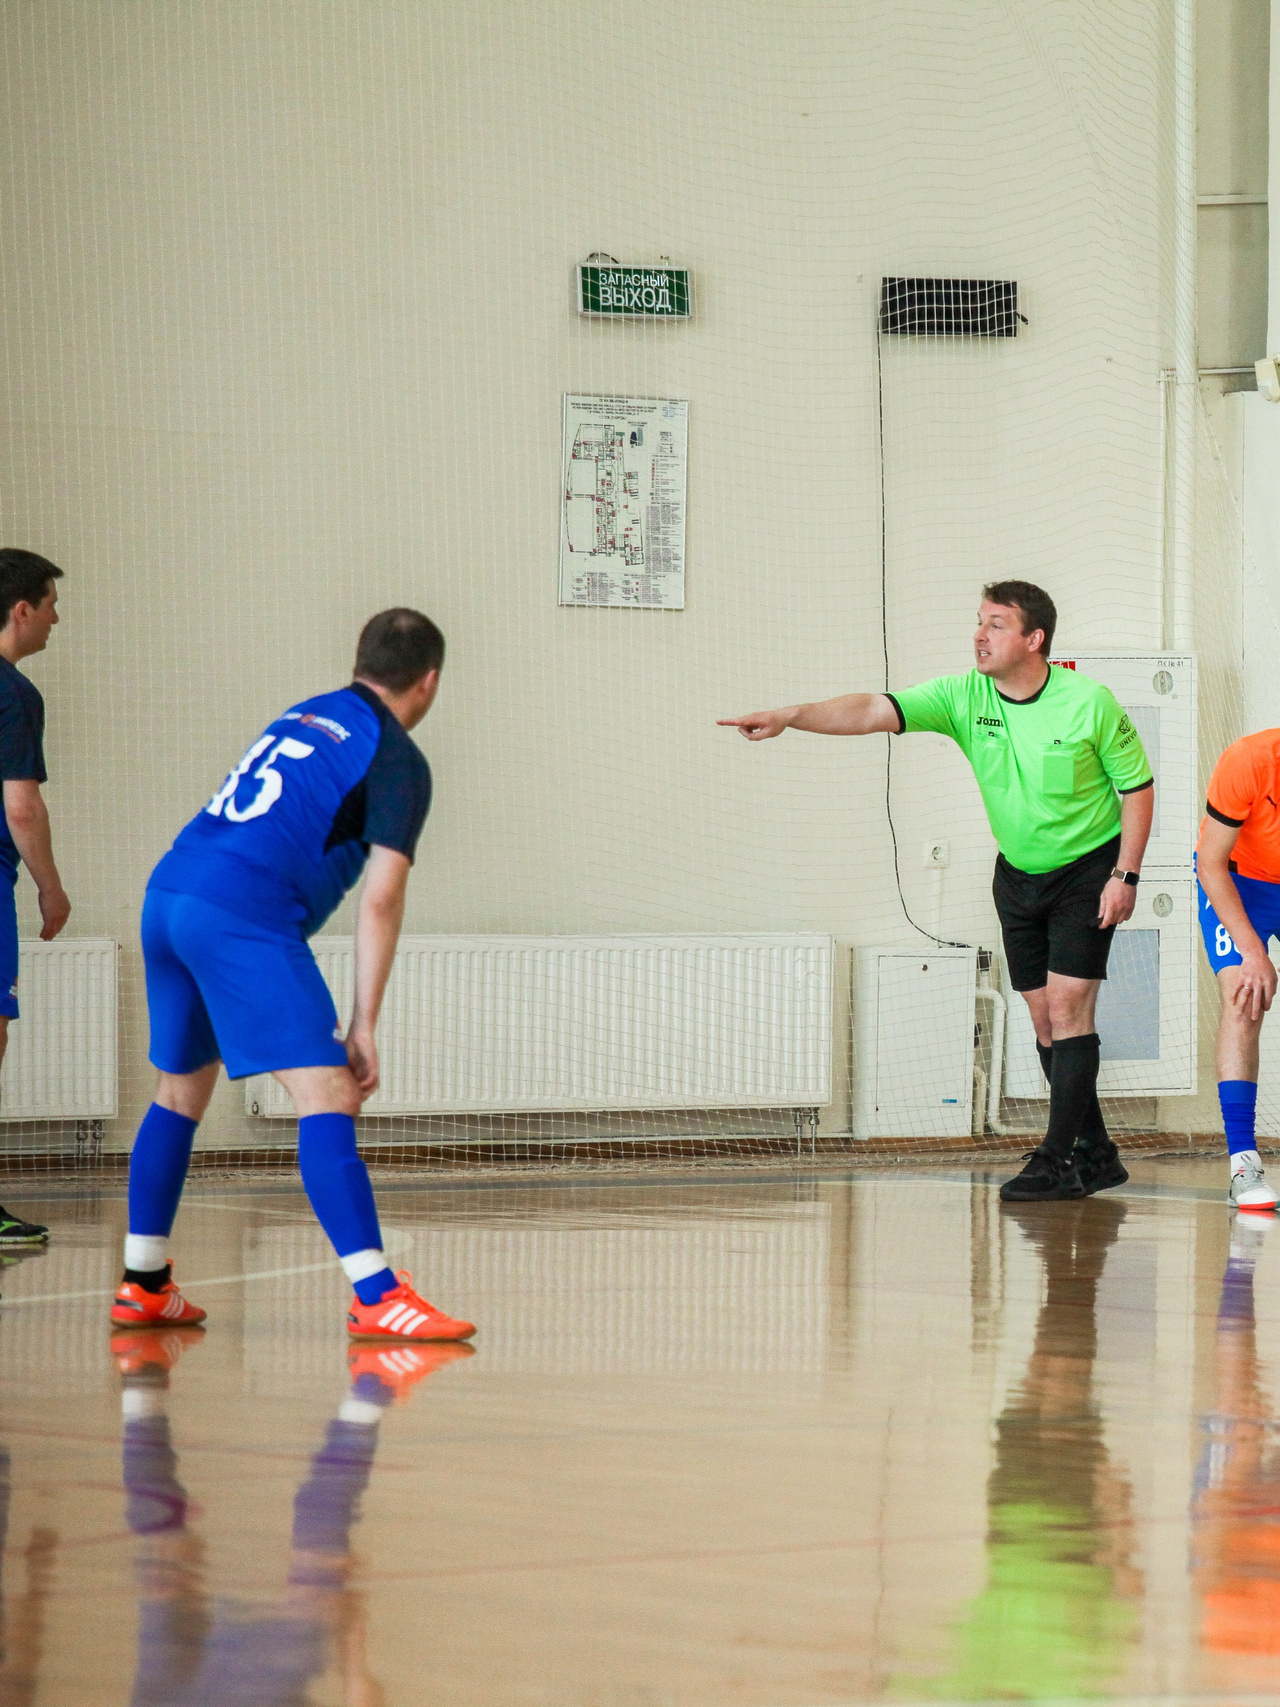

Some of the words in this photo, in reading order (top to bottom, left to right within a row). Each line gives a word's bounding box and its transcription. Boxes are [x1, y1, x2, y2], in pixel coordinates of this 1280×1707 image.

[599, 273, 670, 287] ЗАПАСНЫЙ
[599, 287, 672, 312] ВЫХОД
[206, 734, 316, 823] 15
[1215, 923, 1241, 957] 8
